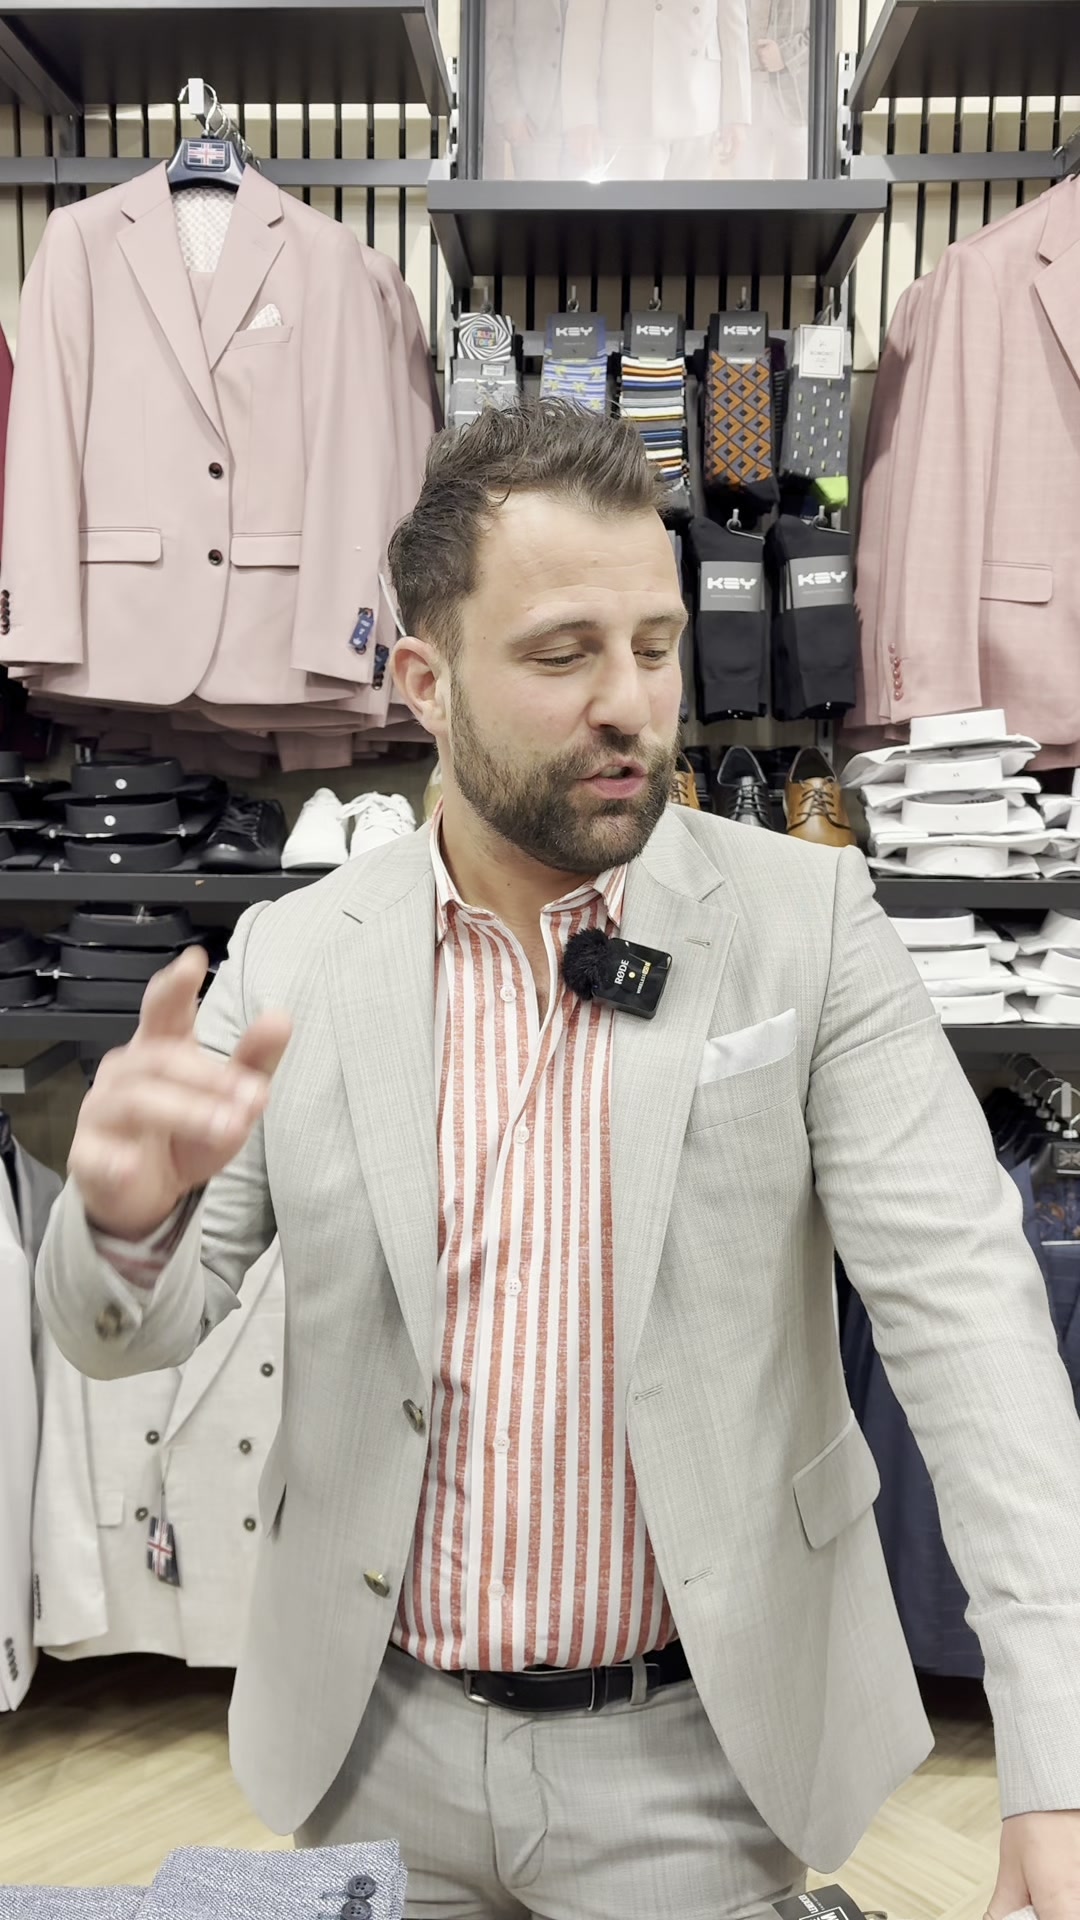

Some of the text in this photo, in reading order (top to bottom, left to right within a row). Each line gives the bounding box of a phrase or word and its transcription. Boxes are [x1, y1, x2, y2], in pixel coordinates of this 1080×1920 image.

[556, 327, 593, 336] KEY
[636, 325, 674, 336] KEY
[723, 325, 762, 336] KEY
[707, 577, 758, 590] KEY
[797, 571, 848, 586] KEY
